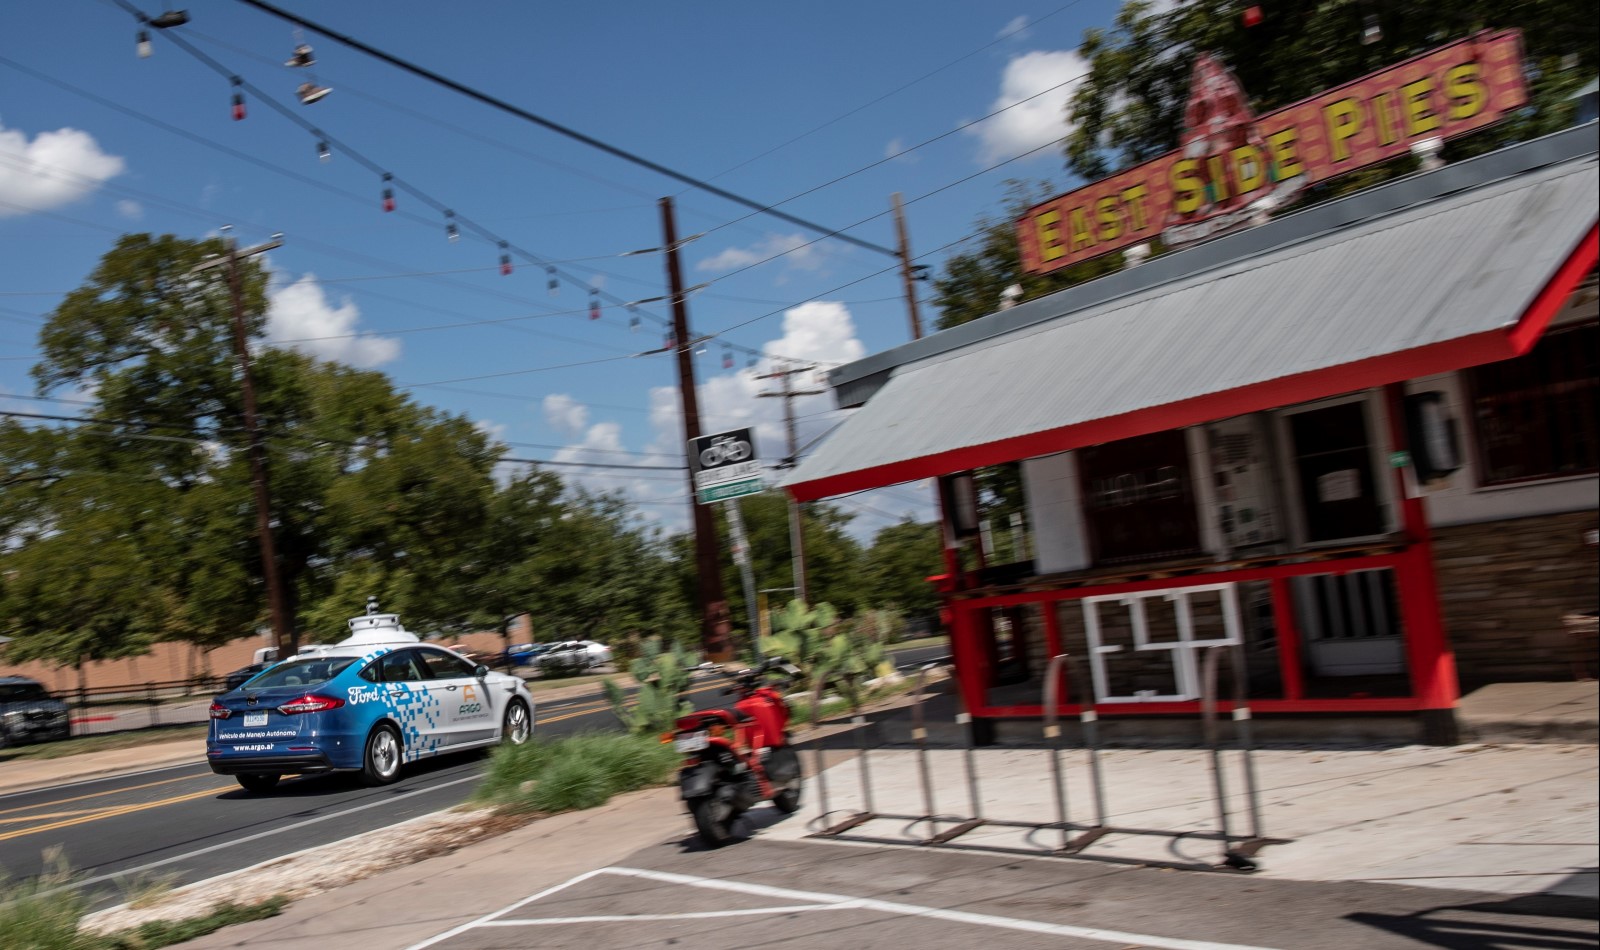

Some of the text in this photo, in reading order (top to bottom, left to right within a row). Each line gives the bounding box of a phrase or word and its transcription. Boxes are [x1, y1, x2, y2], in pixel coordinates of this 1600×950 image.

[1034, 181, 1149, 262] EAST
[1168, 128, 1303, 213] SIDE
[1321, 62, 1489, 163] PIES
[347, 685, 380, 705] Ford
[459, 703, 481, 715] ARGO
[246, 731, 265, 739] Manejo
[266, 730, 296, 738] Autónomo
